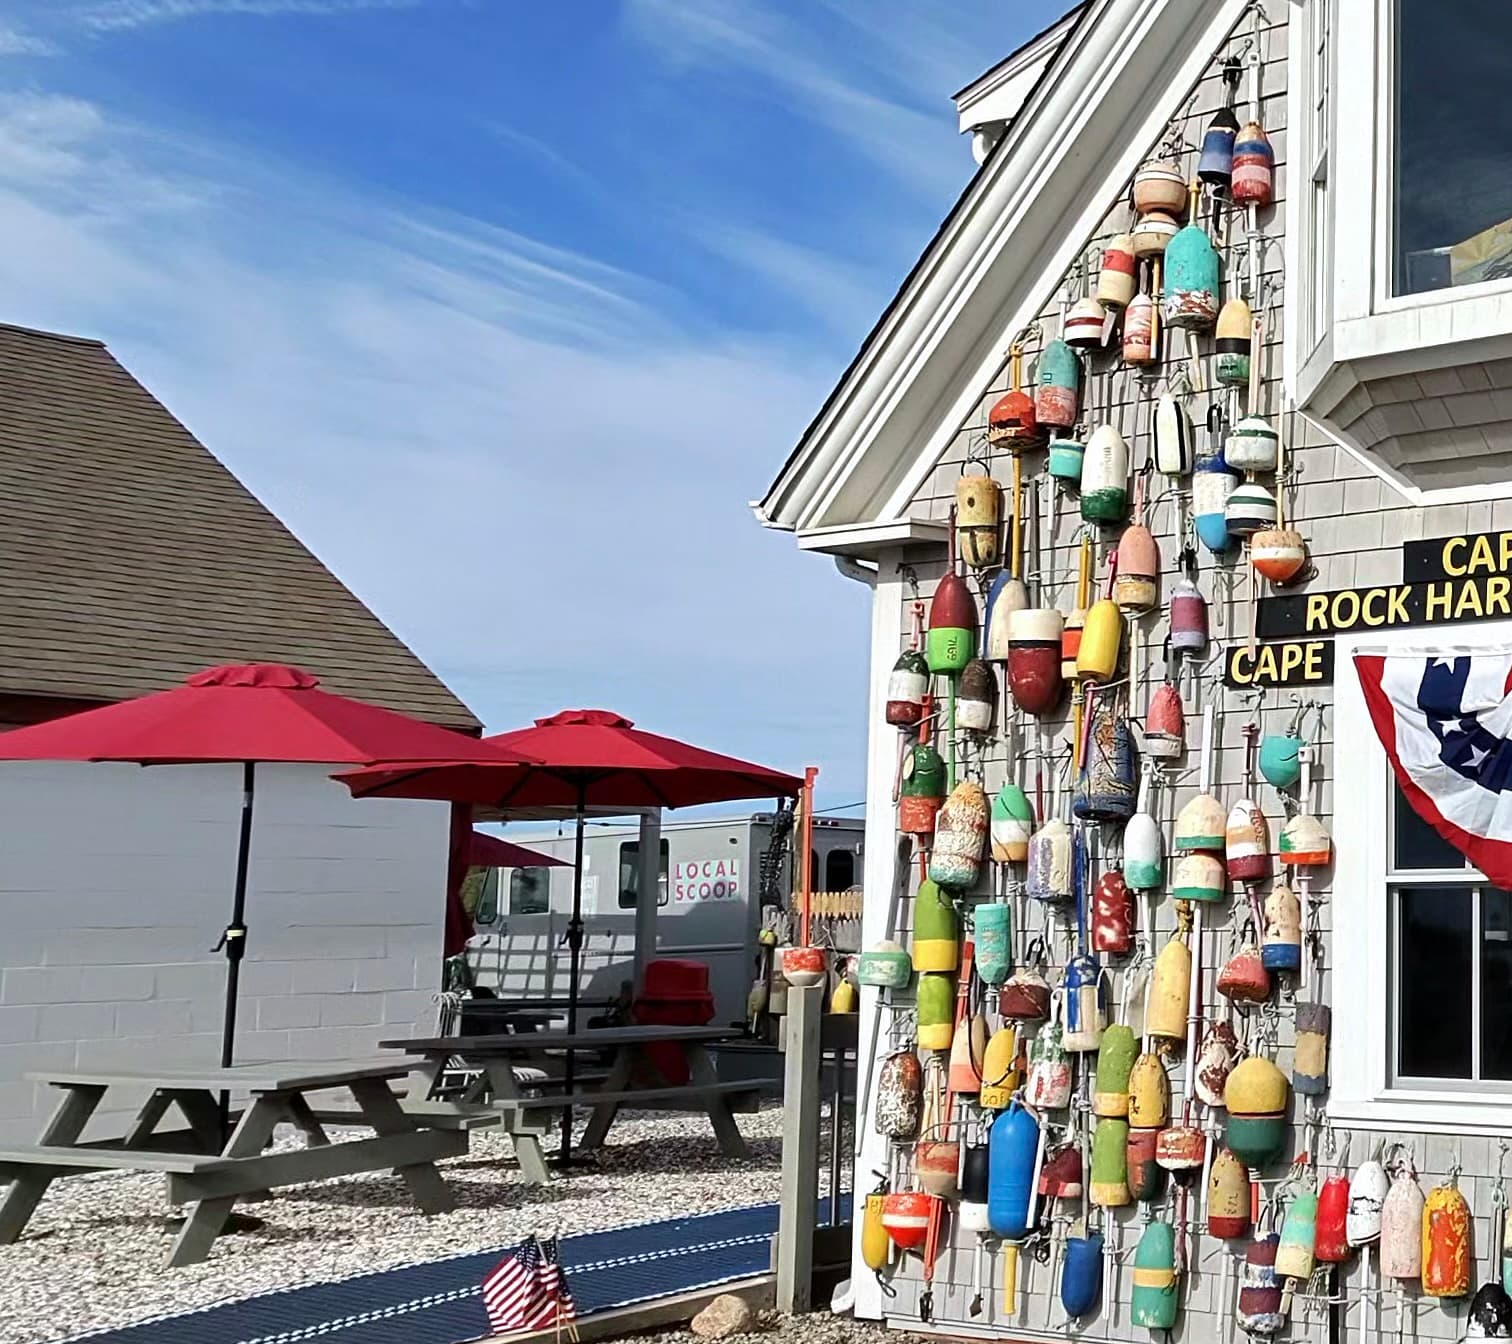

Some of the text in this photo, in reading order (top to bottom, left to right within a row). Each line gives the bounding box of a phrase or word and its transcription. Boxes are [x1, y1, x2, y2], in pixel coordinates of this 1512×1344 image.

[1305, 585, 1412, 633] ROCK
[1229, 641, 1325, 685] CAPE
[675, 859, 737, 880] LOCAL
[675, 880, 738, 901] SCOOP
